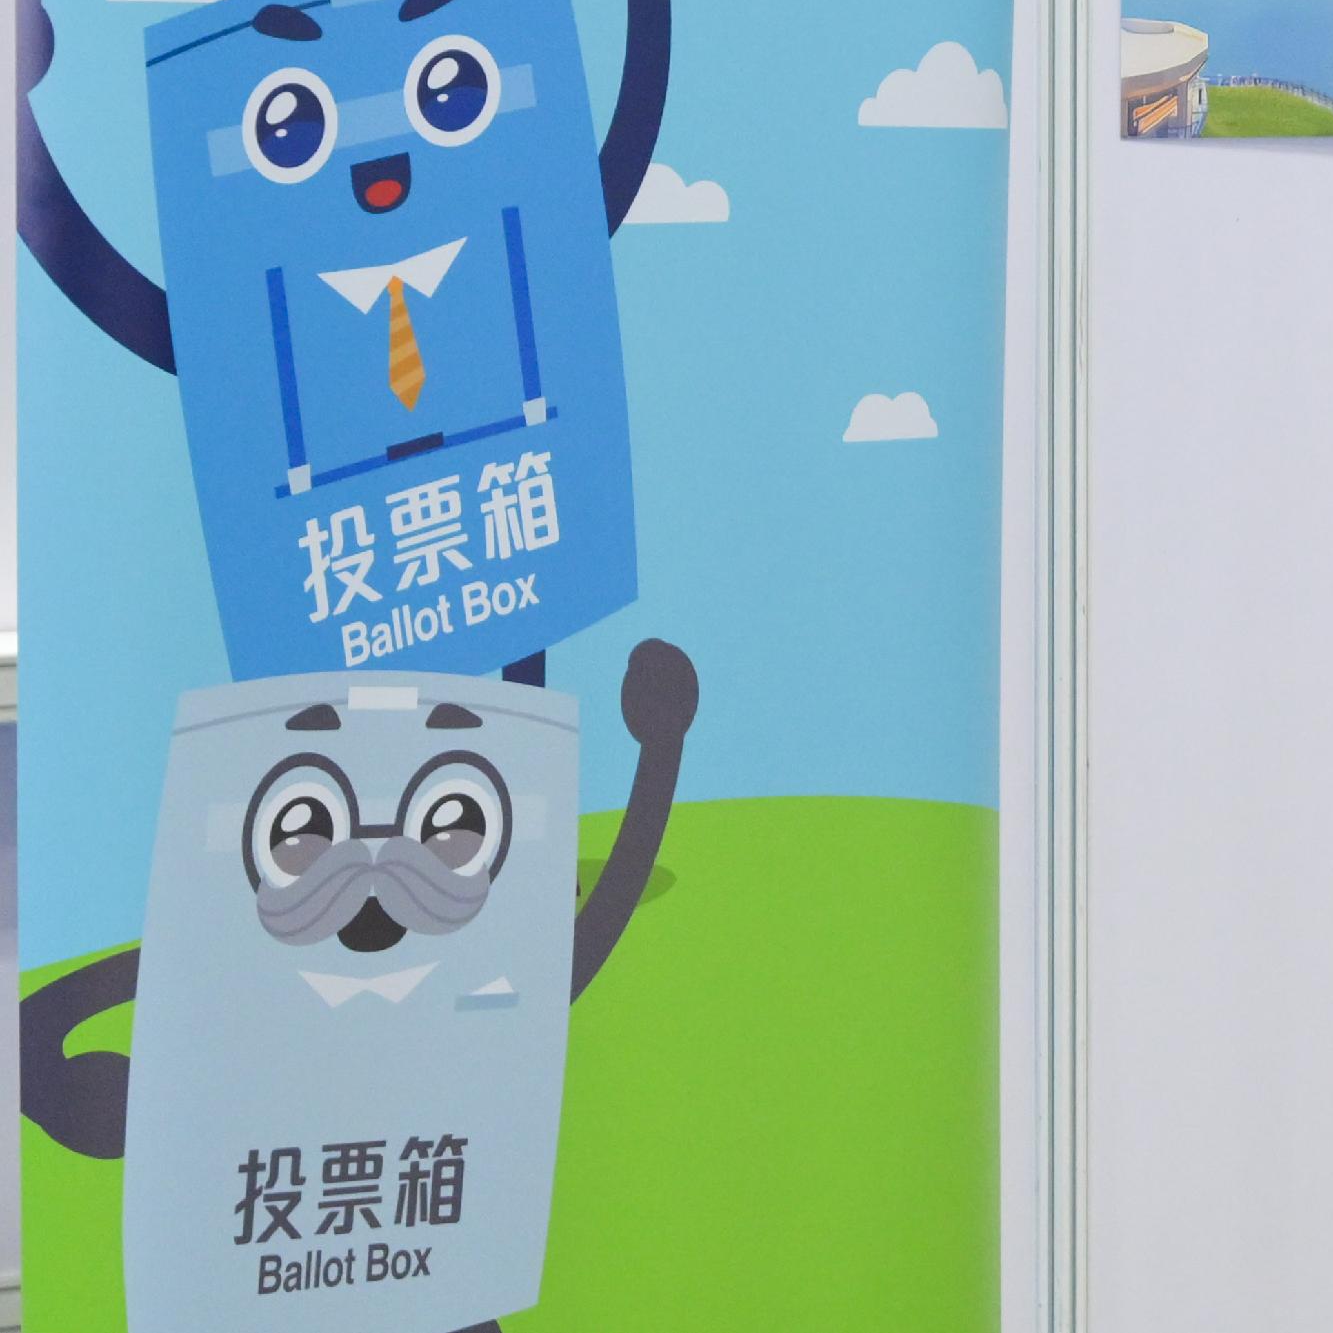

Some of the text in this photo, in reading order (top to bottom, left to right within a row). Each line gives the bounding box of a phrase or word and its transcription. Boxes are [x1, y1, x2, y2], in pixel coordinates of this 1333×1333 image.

[298, 450, 560, 623] 投票箱
[341, 574, 540, 668] Ballot Box
[233, 1133, 468, 1245] 投票箱
[257, 1242, 433, 1295] Ballot Box
